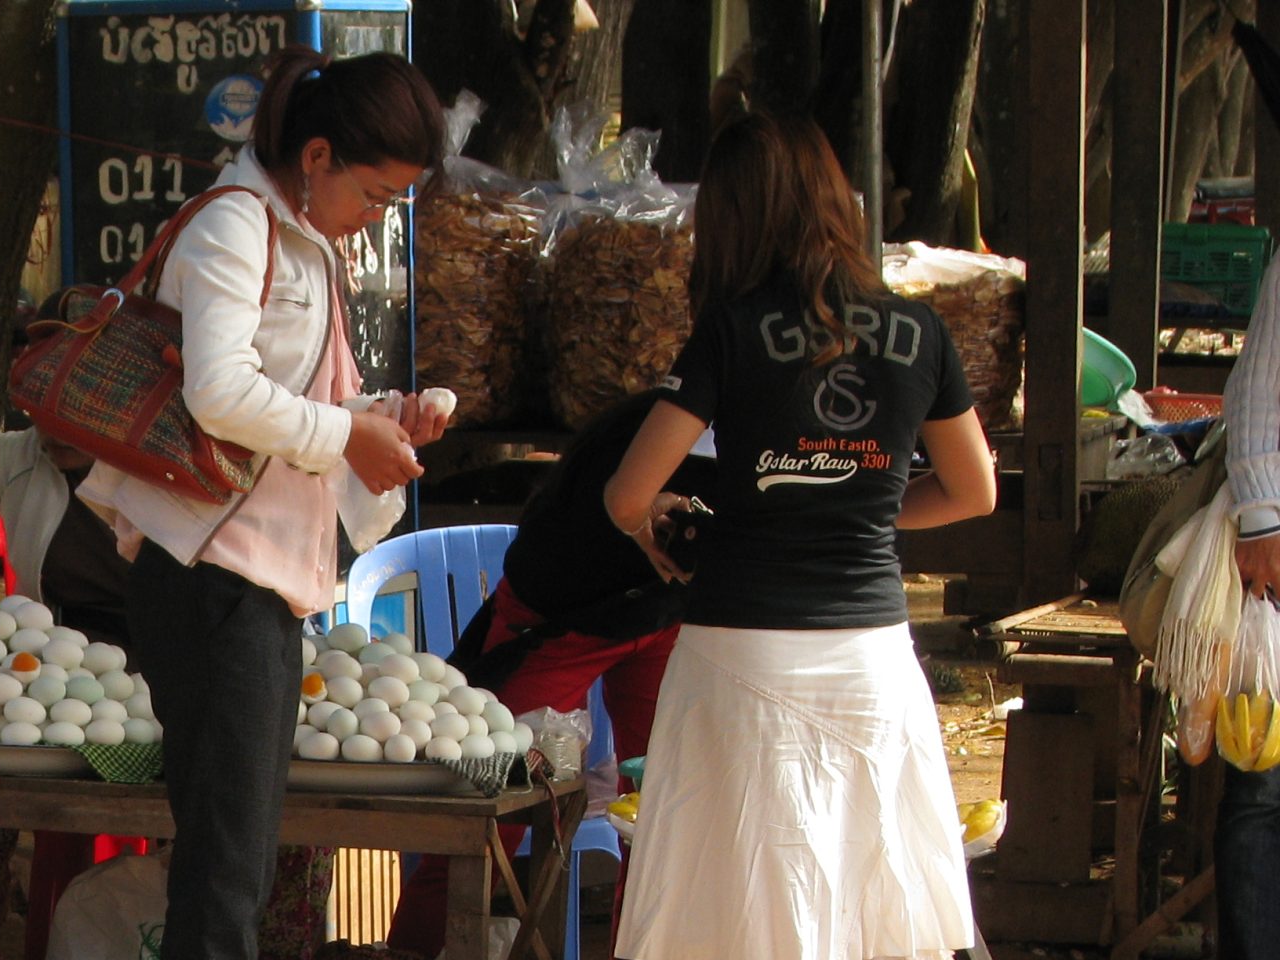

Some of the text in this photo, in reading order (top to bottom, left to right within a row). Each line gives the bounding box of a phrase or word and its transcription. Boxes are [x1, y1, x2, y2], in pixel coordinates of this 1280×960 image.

[98, 153, 187, 205] 011
[100, 220, 167, 263] 01
[798, 437, 836, 451] South
[756, 450, 858, 472] Gstar Raw
[861, 454, 891, 469] 3301
